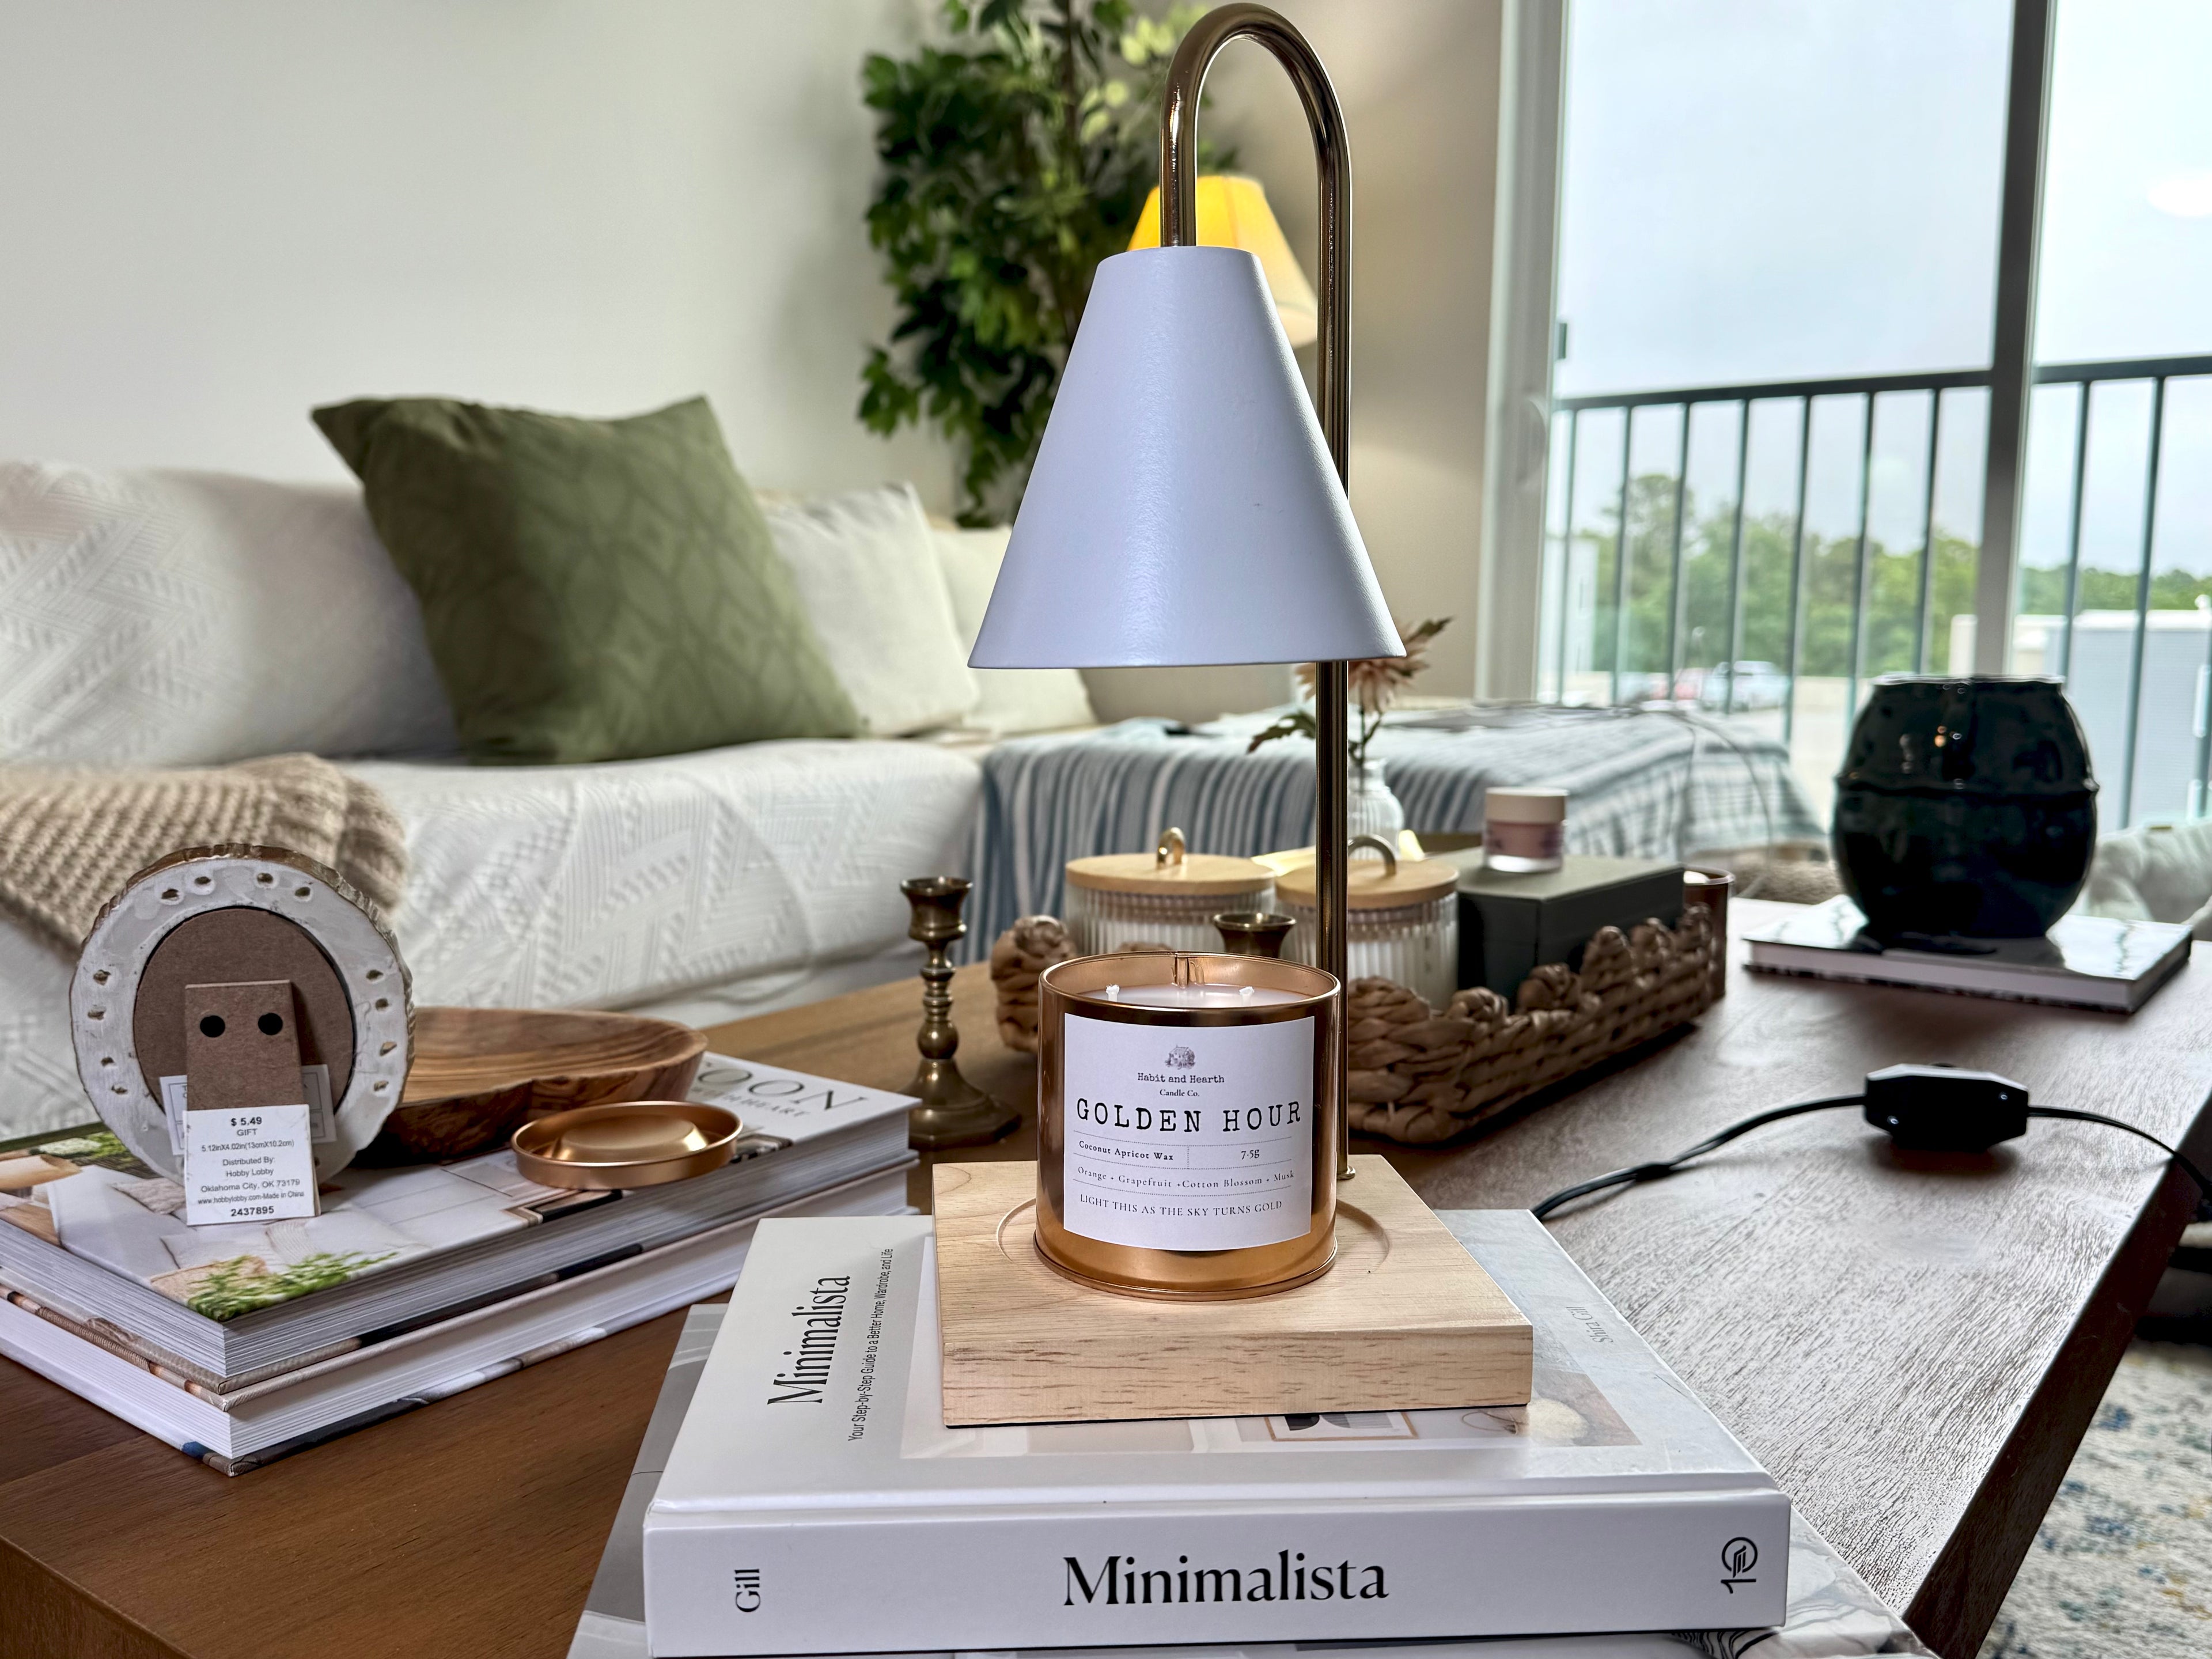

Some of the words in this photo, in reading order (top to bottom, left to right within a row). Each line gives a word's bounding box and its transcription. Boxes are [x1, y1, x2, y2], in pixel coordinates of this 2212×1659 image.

[698, 1063, 868, 1110] OON
[1138, 1073, 1165, 1082] Habit
[1190, 1075, 1225, 1084] Hearth
[1160, 1089, 1185, 1097] Candle
[231, 1118, 237, 1126] $
[241, 1116, 262, 1126] 5.49
[1077, 1098, 1201, 1132] GOLDEN
[1223, 1101, 1301, 1132] HOUR
[237, 1128, 258, 1137] GIFT
[1079, 1141, 1111, 1155] Coconut
[1115, 1147, 1149, 1159] Apricot
[1154, 1153, 1173, 1161] Wax
[223, 1157, 262, 1166] Distributed
[226, 1169, 249, 1177] Hobby
[1078, 1166, 1107, 1180] Orange
[1119, 1175, 1172, 1188] Grapefruit
[1224, 1177, 1262, 1187] Blossom
[1274, 1171, 1294, 1182] Musk
[201, 1184, 240, 1192] Oklahoma
[277, 1179, 300, 1187] 73179
[288, 1190, 304, 1198] China
[231, 1206, 274, 1217] 2437895
[1080, 1194, 1109, 1208] LIGHT
[1112, 1201, 1137, 1212] THIS
[1142, 1206, 1156, 1214] AS
[1160, 1207, 1183, 1216] THE
[1187, 1208, 1209, 1216] SKY
[1213, 1205, 1251, 1216] TURNS
[1255, 1200, 1282, 1213] GOLD
[881, 1249, 893, 1258] Life
[880, 1259, 892, 1270] and
[874, 1271, 892, 1299] Wardrobe,
[870, 1300, 887, 1318] Home,
[1566, 1306, 1593, 1320] Gill
[867, 1320, 881, 1339] Better
[1586, 1321, 1613, 1343] Shira
[767, 1275, 850, 1405] Minimalista
[861, 1354, 876, 1374] Guide
[851, 1375, 876, 1422] Step-by-Step
[848, 1423, 864, 1441] Your
[1063, 1549, 1389, 1606] Minimalista
[734, 1569, 761, 1612] Gill
